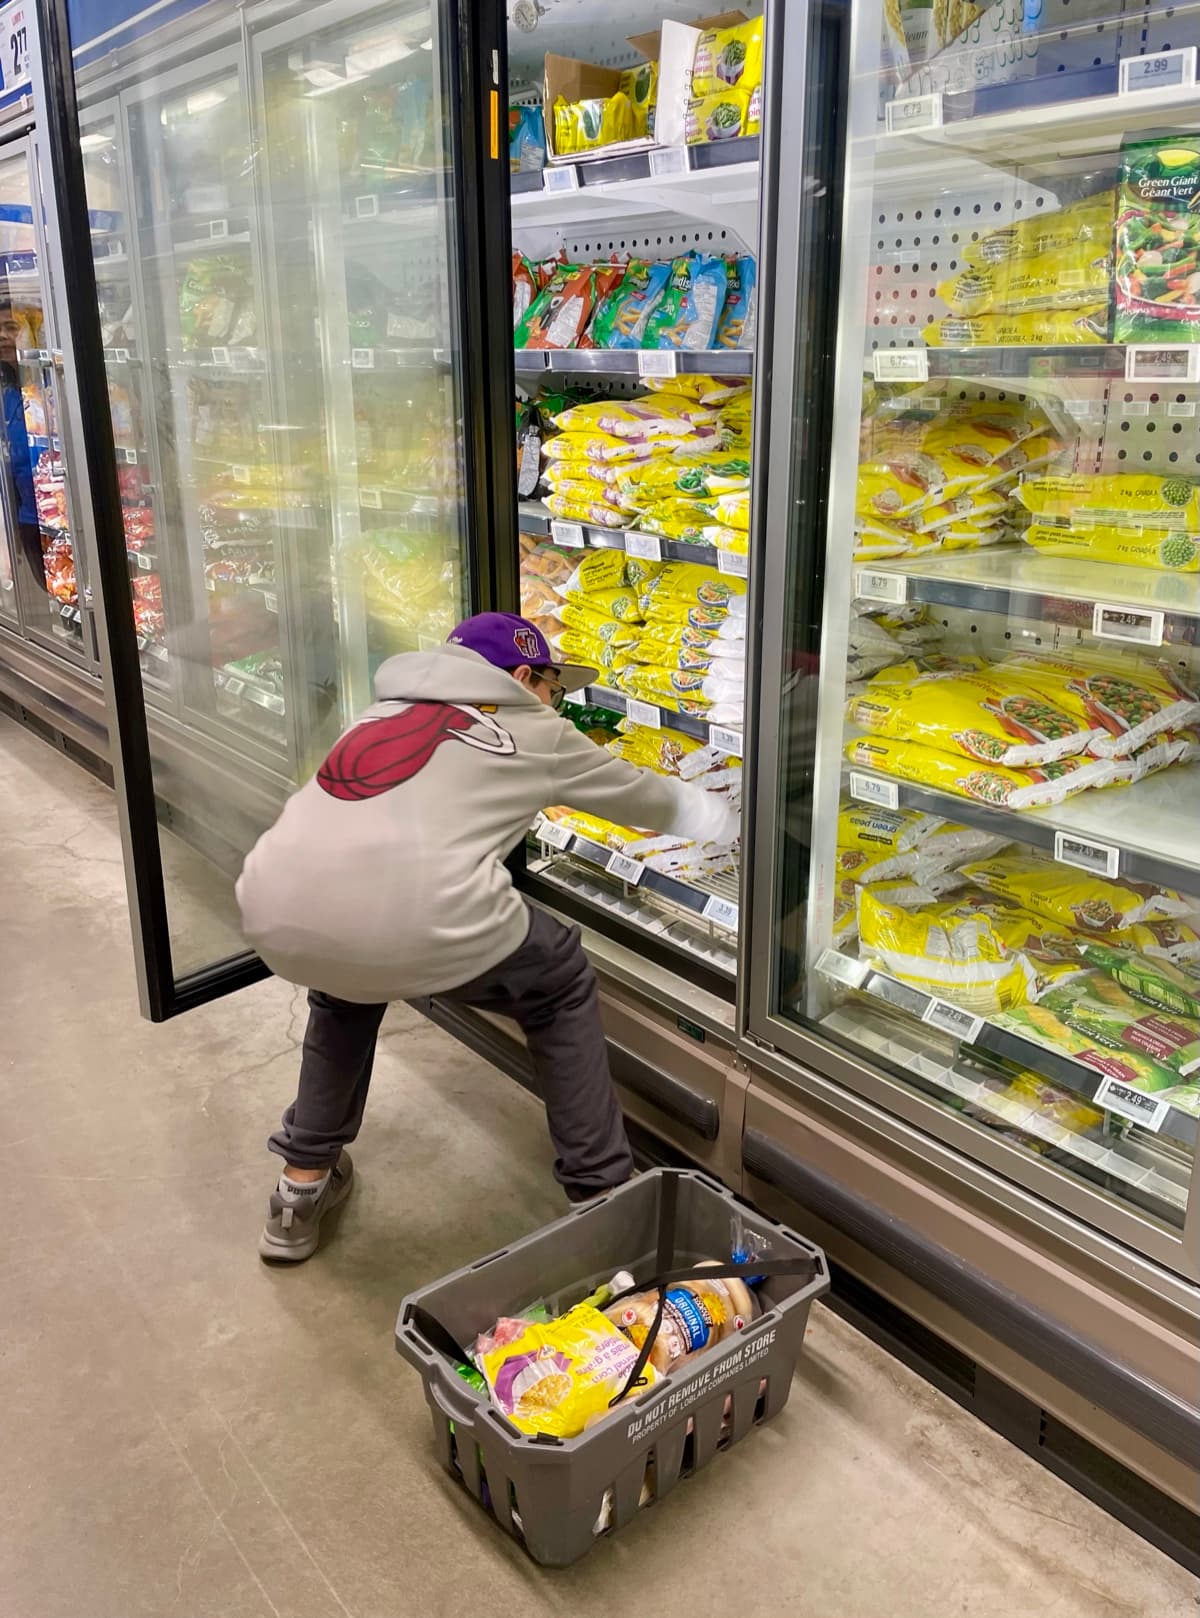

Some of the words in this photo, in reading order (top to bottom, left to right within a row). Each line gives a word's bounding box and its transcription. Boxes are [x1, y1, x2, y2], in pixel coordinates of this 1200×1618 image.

[1143, 58, 1168, 74] 2.99
[1138, 176, 1169, 187] Green
[1170, 175, 1198, 186] Giant
[1140, 187, 1171, 197] Géant
[1172, 186, 1193, 196] Vert
[872, 822, 897, 832] green
[1124, 1090, 1142, 1105] 2.49
[675, 1296, 701, 1339] ORIGINAL
[592, 1367, 614, 1384] corn
[627, 1419, 642, 1438] DO
[645, 1403, 665, 1426] NOT
[668, 1371, 711, 1407] REMOVE
[713, 1350, 743, 1378] FROM
[744, 1329, 777, 1357] STORE
[632, 1412, 668, 1444] PROPERTY
[668, 1408, 678, 1418] OF
[680, 1388, 708, 1410] LOBLAW
[708, 1361, 745, 1391] COMPANIES
[744, 1347, 769, 1368] LIMITED
